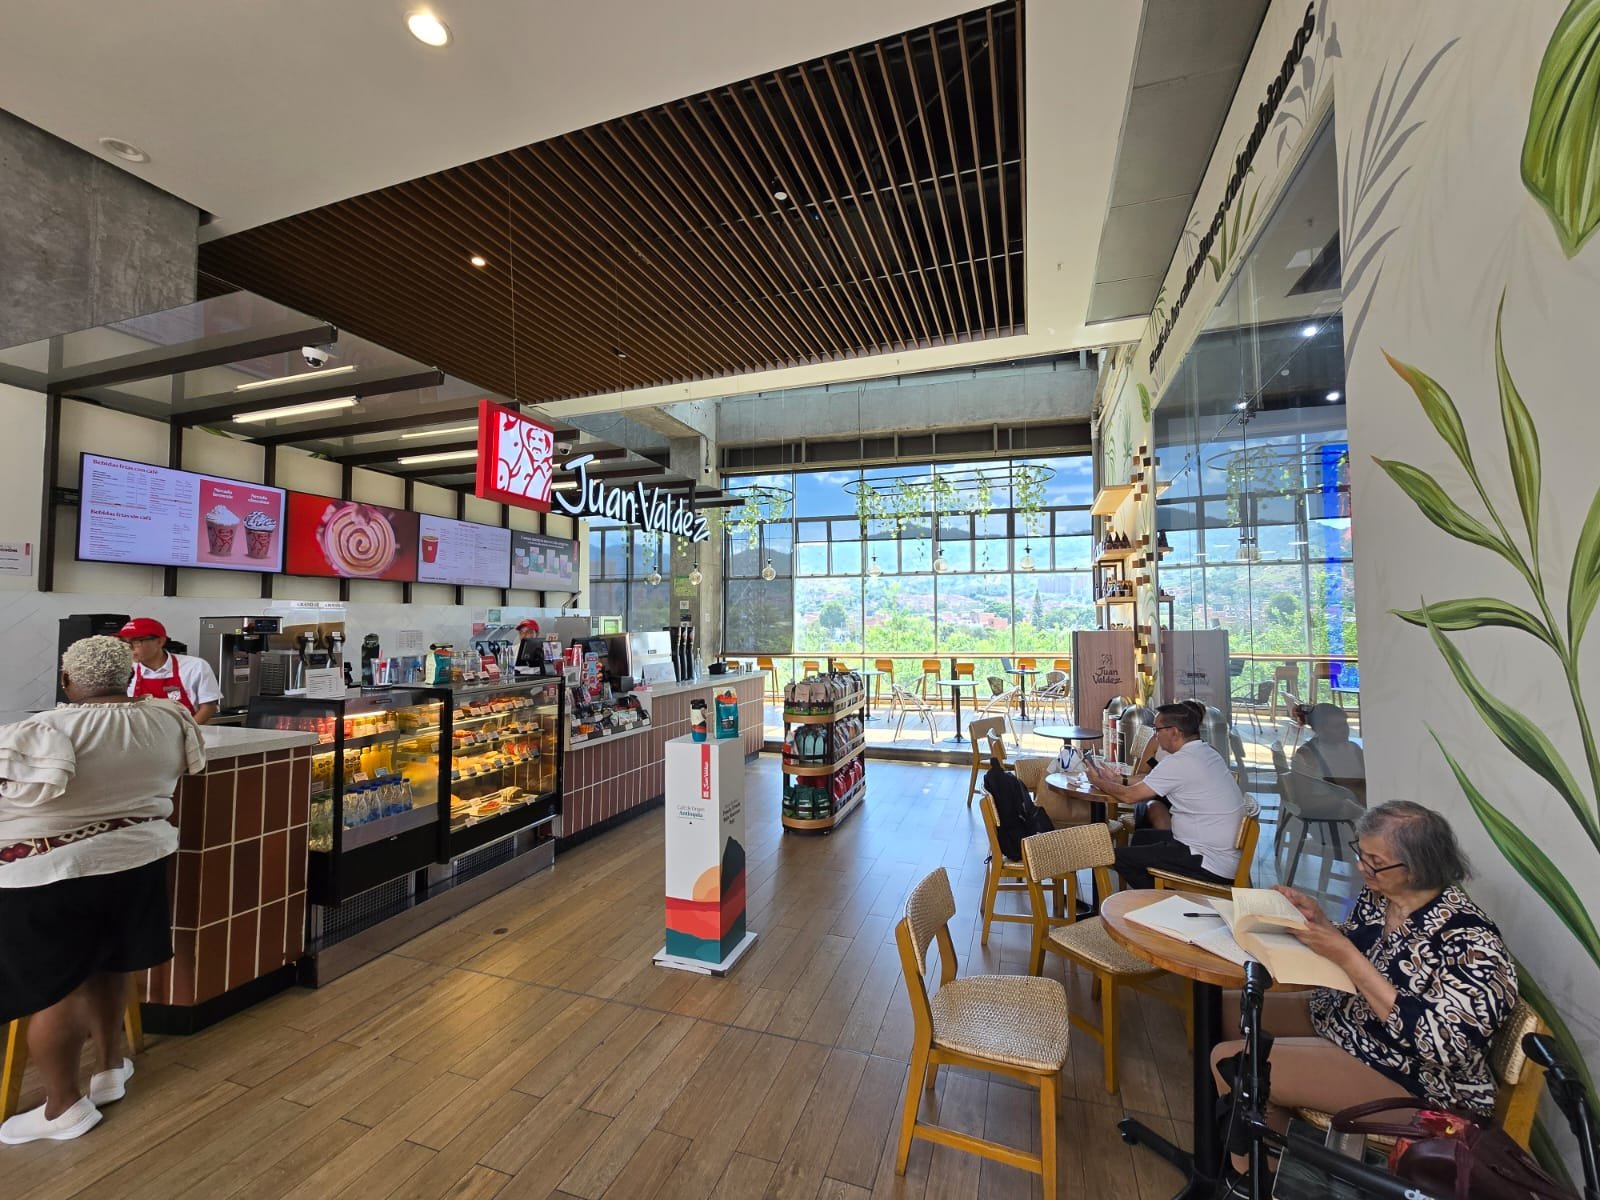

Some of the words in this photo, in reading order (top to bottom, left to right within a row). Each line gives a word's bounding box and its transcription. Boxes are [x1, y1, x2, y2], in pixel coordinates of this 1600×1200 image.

[1223, 0, 1315, 211] colombianos
[93, 459, 118, 468] Bebidas
[555, 453, 637, 523] Juan
[637, 480, 711, 543] Valdez
[90, 508, 115, 517] Bebidas
[1095, 666, 1119, 677] Juan
[1092, 674, 1123, 684] Valdez
